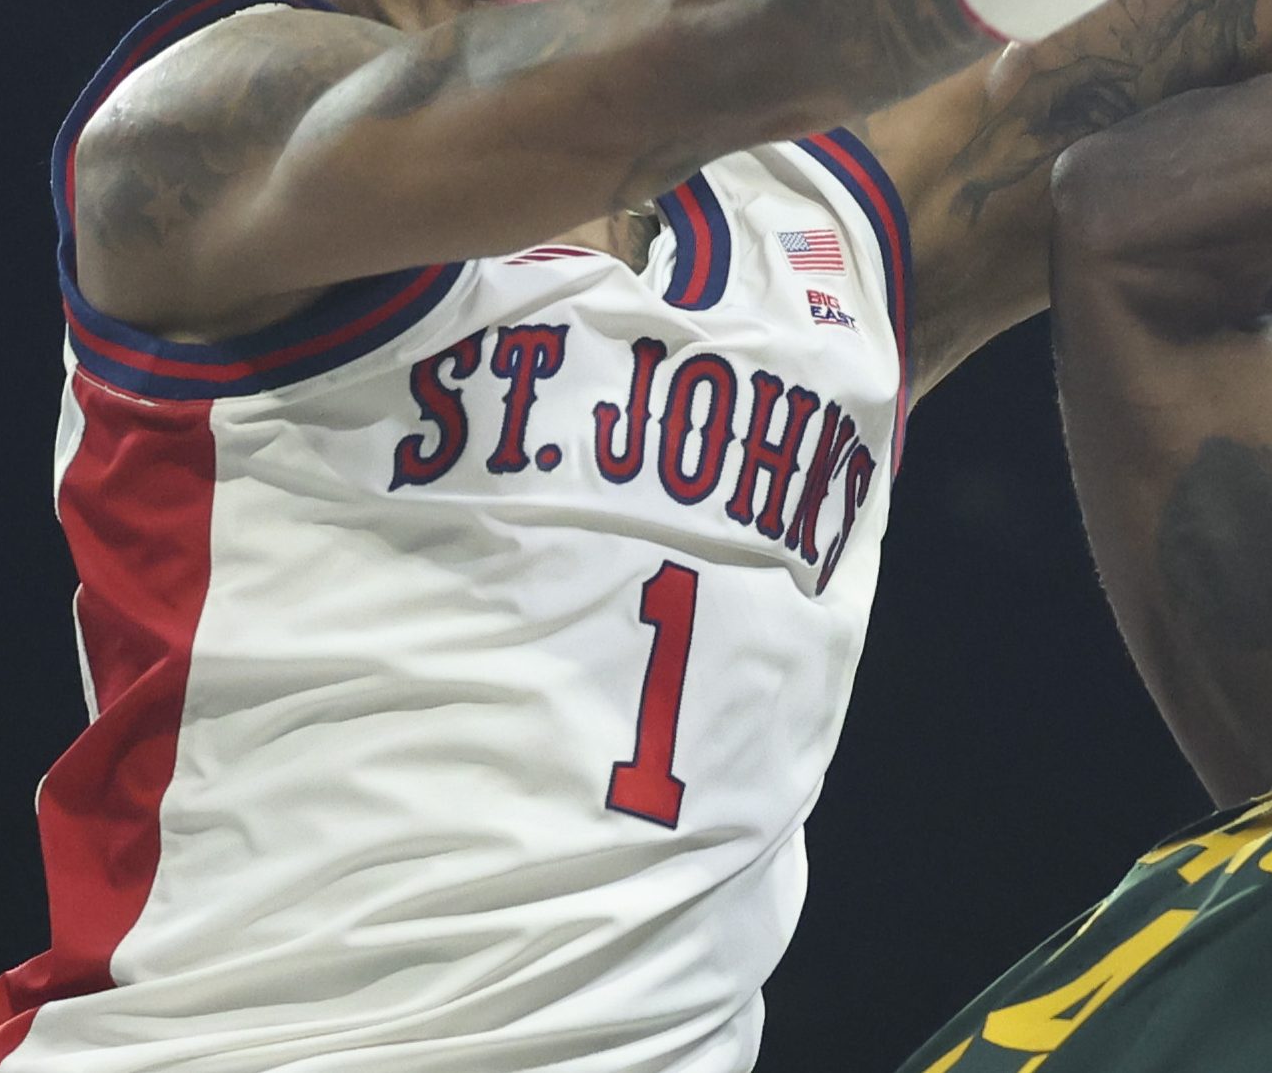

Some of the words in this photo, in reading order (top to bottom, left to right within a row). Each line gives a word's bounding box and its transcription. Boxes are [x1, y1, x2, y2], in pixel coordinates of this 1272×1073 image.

[806, 289, 841, 310] BIG
[810, 305, 857, 329] EAST
[387, 324, 570, 492] ST.
[593, 336, 877, 596] JOHN'S
[605, 559, 699, 830] 1
